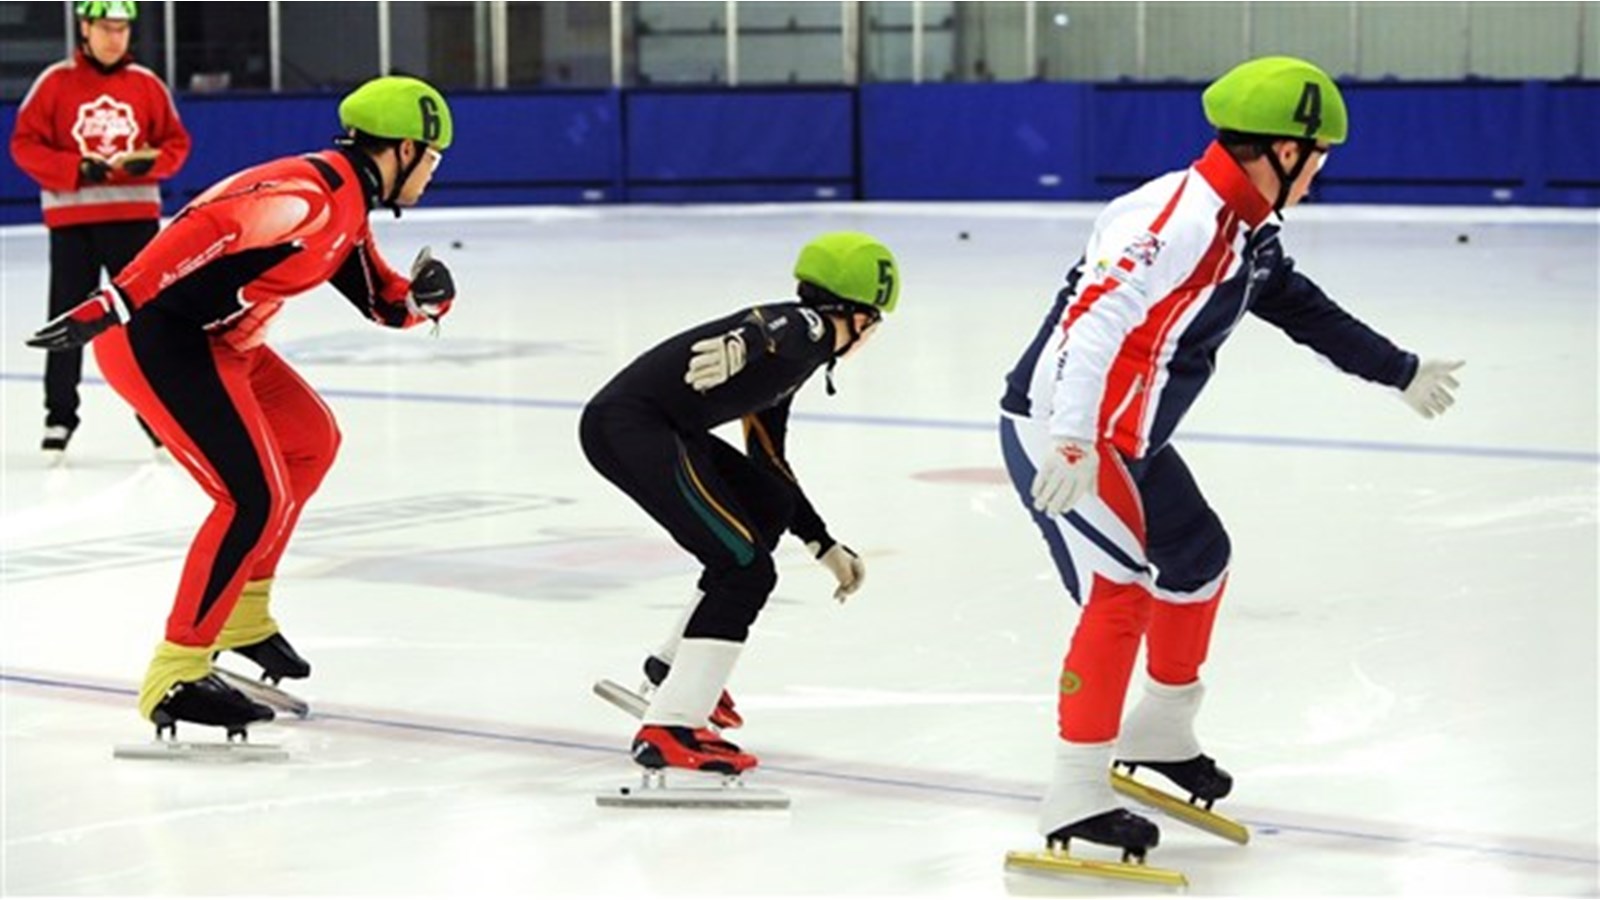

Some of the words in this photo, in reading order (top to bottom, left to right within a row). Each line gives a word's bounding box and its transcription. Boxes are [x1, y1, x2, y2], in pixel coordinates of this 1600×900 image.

[419, 96, 441, 141] 6
[1293, 82, 1322, 135] 4
[875, 260, 893, 306] 5
